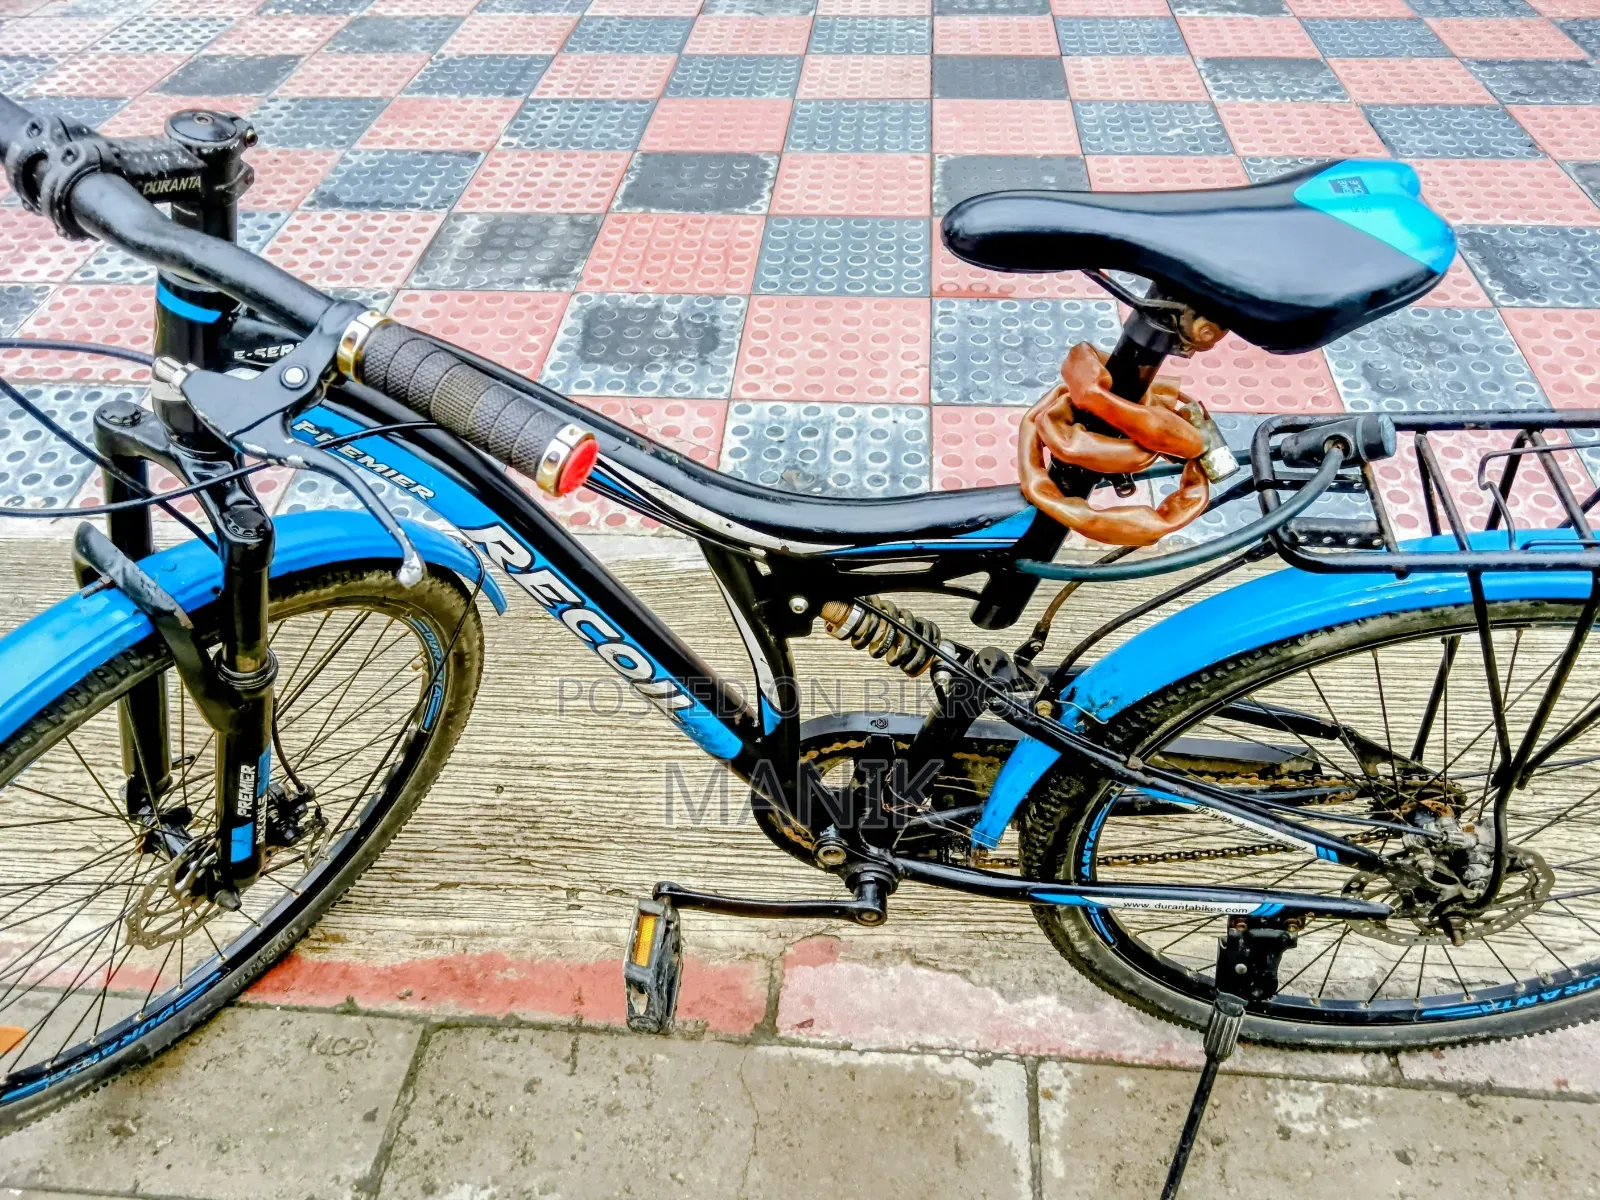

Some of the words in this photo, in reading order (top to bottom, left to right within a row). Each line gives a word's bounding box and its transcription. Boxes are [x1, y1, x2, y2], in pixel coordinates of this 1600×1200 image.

[143, 175, 202, 195] DURANTA
[233, 343, 302, 360] E-SER
[237, 765, 256, 817] PREMIER
